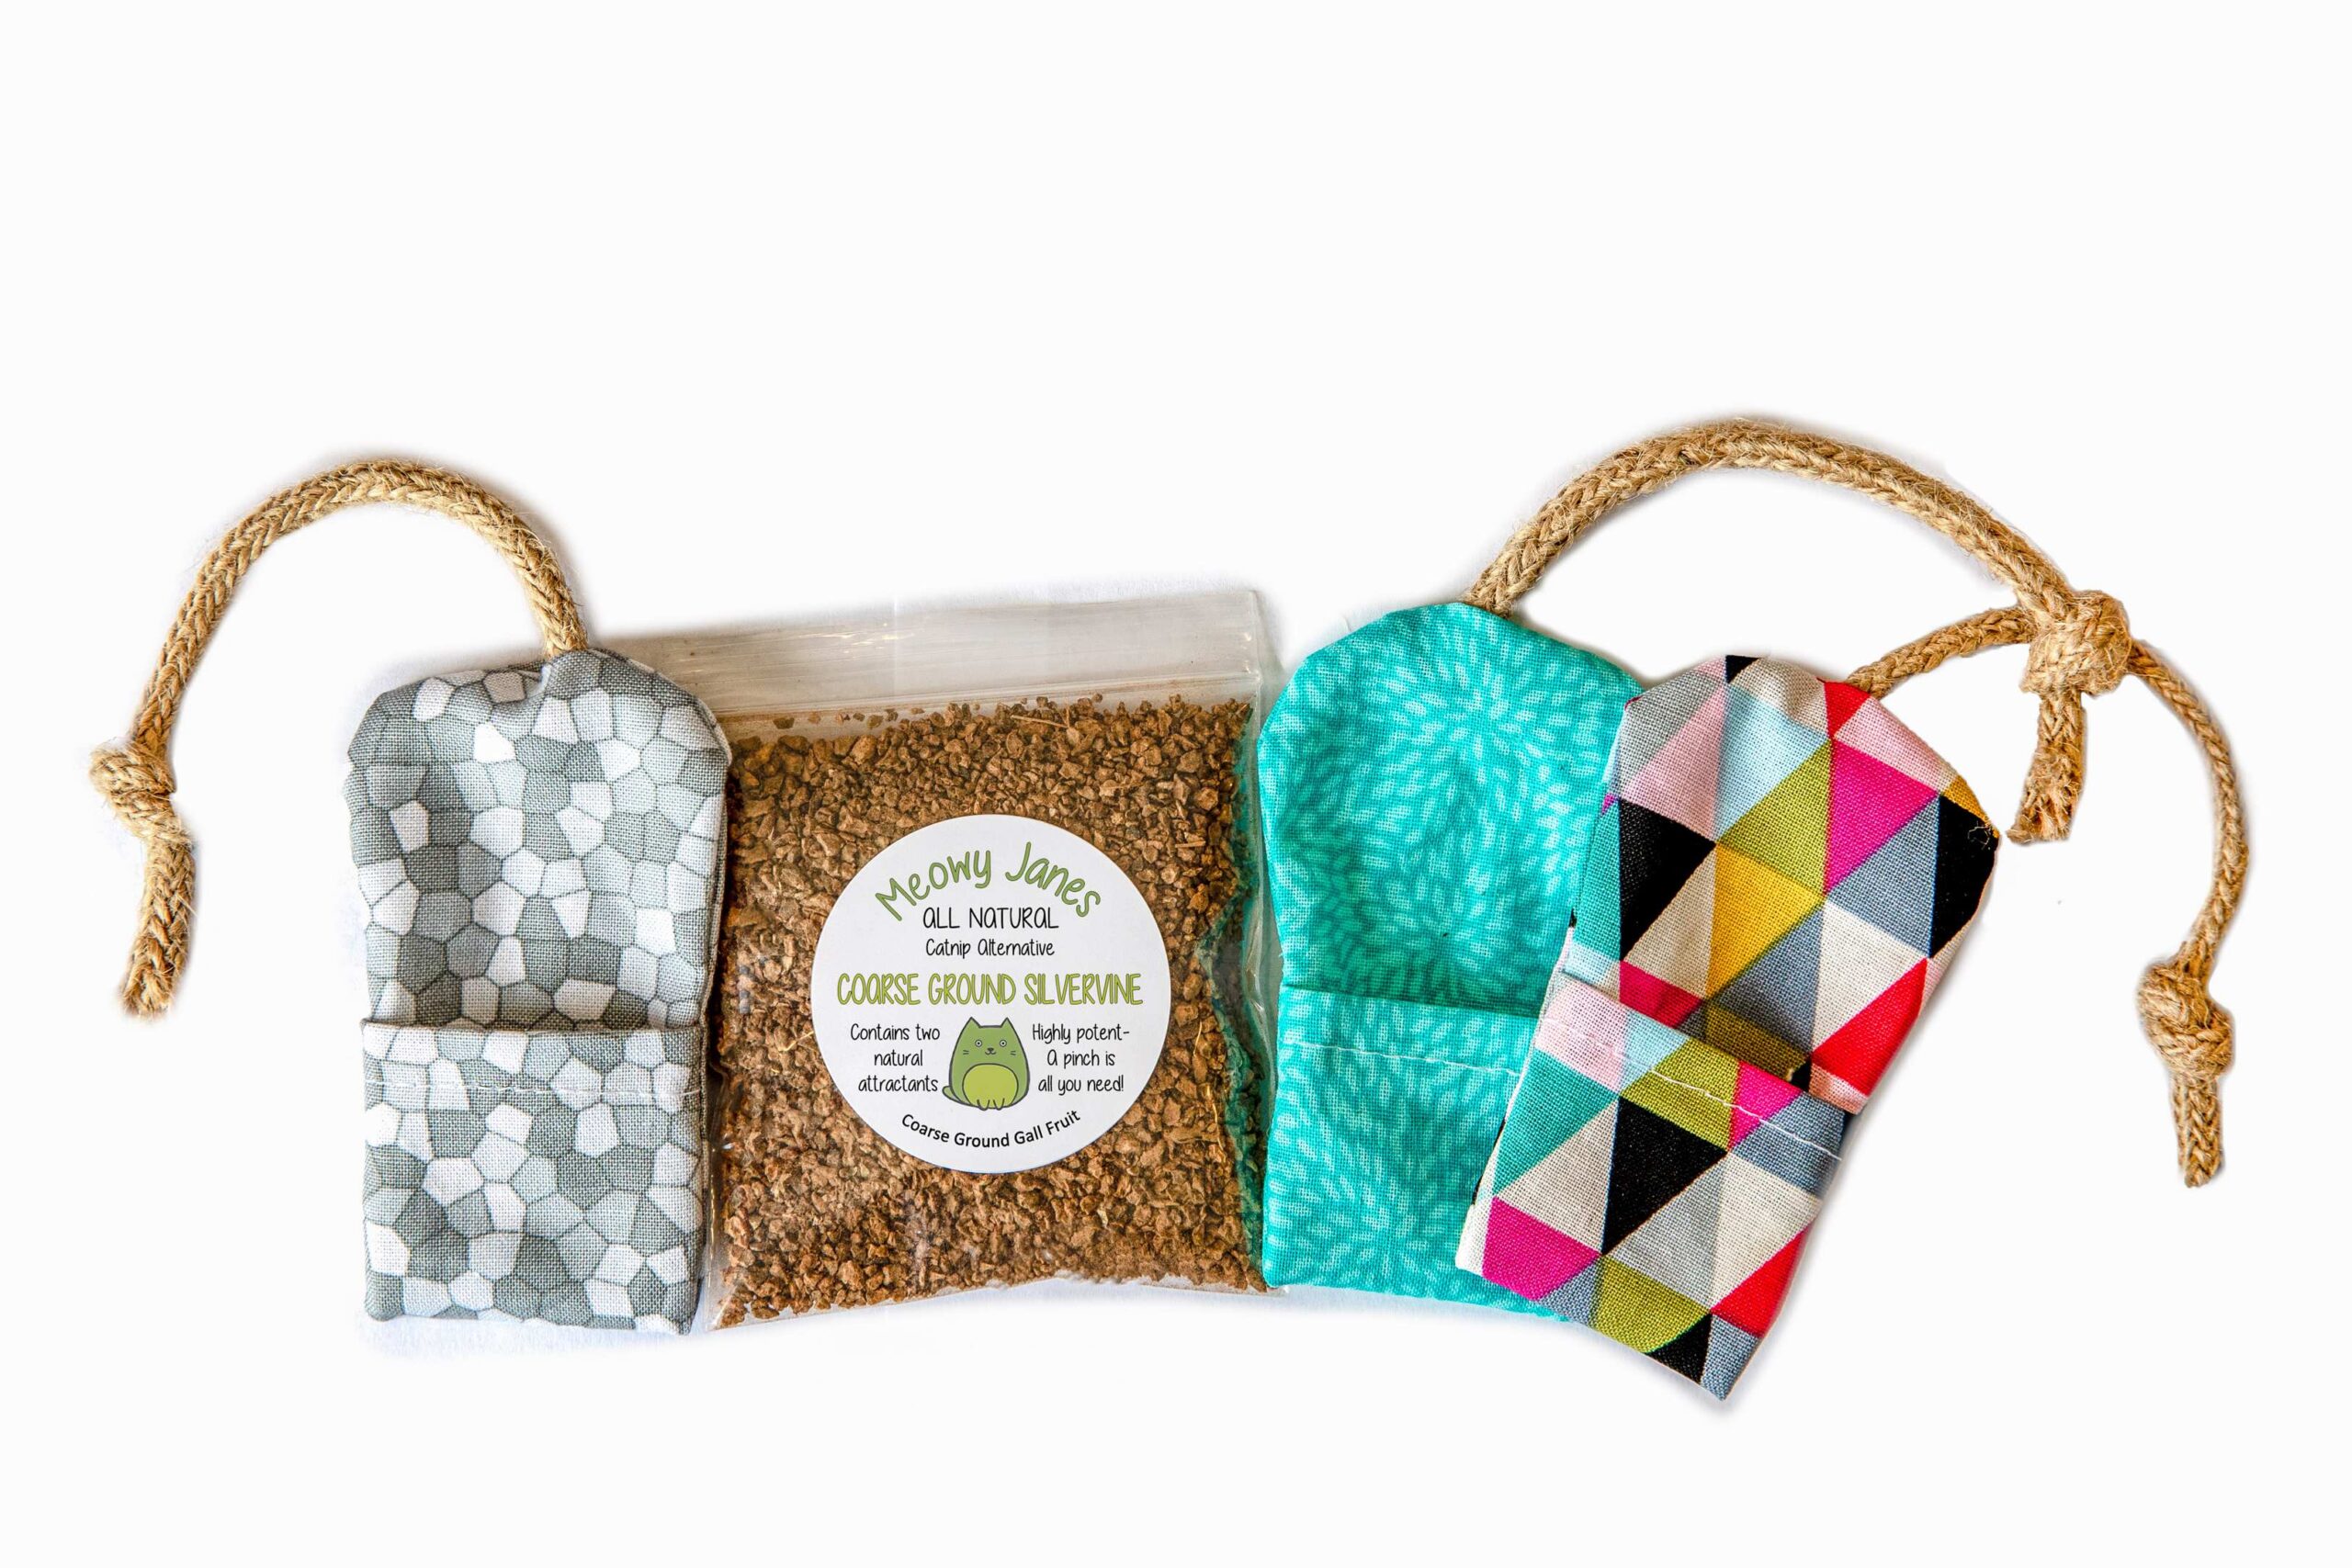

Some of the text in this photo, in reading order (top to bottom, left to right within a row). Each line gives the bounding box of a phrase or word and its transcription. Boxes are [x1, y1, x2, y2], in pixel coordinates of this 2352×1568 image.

[875, 841, 1102, 922] Meowy Janes
[922, 907, 1059, 930] ALL NATURAL
[925, 938, 1056, 960] Catnip Alternative
[837, 973, 1144, 1006] COARSE GROUND SILVERVINE
[850, 1022, 941, 1041] Contains two
[1032, 1022, 1130, 1045] Highly potent-
[874, 1049, 923, 1066] natural
[1046, 1048, 1116, 1070] A pinch is
[857, 1075, 939, 1092] attractants
[1037, 1074, 1125, 1097] all you need!
[901, 1110, 1081, 1148] Coarse Ground Gall Fruit
